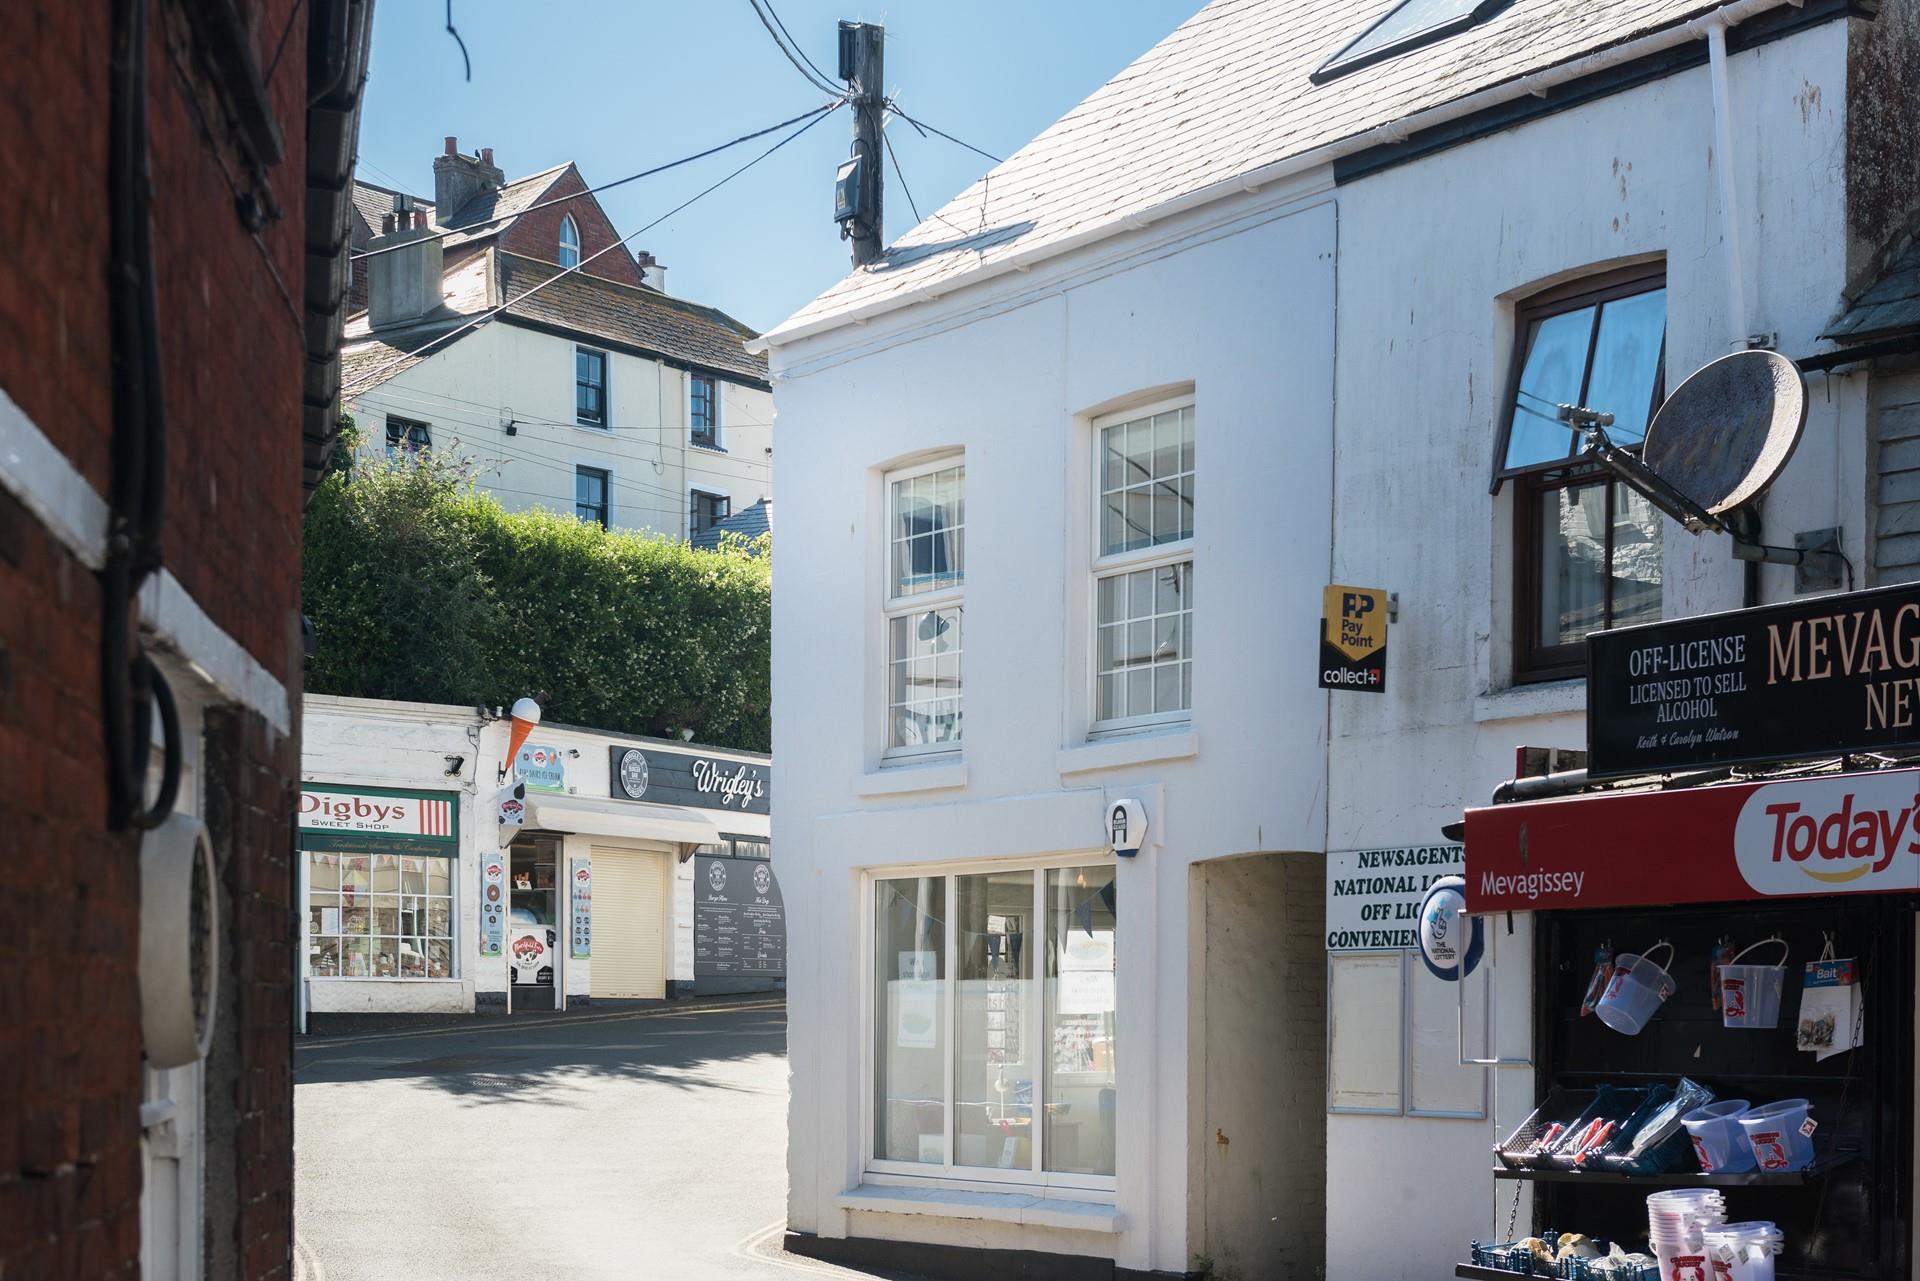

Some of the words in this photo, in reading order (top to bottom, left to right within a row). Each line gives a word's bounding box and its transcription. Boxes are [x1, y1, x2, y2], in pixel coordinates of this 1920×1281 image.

[1341, 619, 1363, 635] Pay
[1341, 633, 1373, 648] Point
[1629, 635, 1746, 677] OFF-LICENSE
[1629, 678, 1691, 705] LICENSED
[1695, 677, 1712, 698] TO
[1714, 671, 1747, 695] SELL
[1656, 697, 1718, 723] ALCOHOL
[1669, 729, 1702, 749] Carolyn
[1705, 728, 1739, 743] Watson
[692, 759, 764, 808] Wrigley's
[299, 793, 406, 823] Digbys
[1357, 846, 1465, 868] NEWSAGENT
[1333, 875, 1417, 896] NATIONAL
[1481, 868, 1585, 900] Mevagissey
[1361, 903, 1392, 921] OFF
[1816, 968, 1838, 979] Bait
